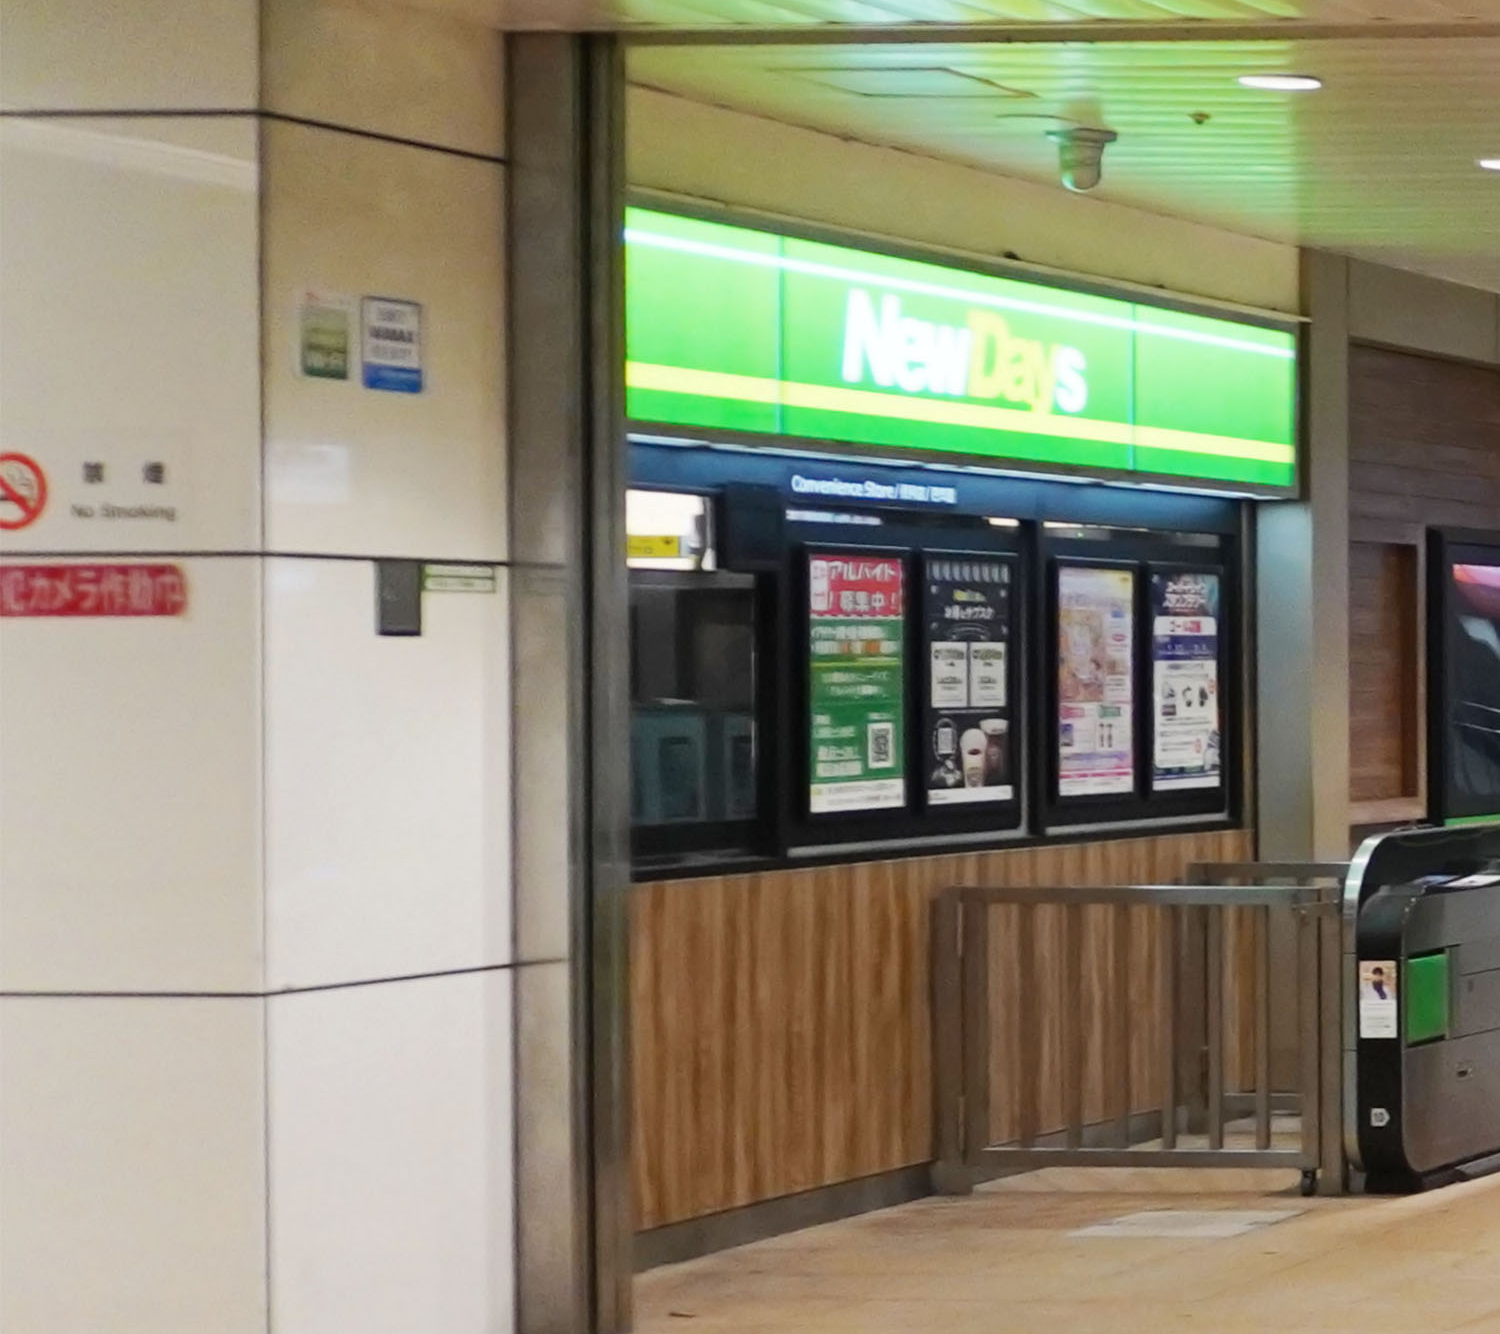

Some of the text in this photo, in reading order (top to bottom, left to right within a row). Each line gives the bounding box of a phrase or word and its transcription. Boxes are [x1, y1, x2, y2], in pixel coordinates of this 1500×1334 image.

[841, 287, 1087, 416] NewDays
[827, 561, 895, 582] アルバイト
